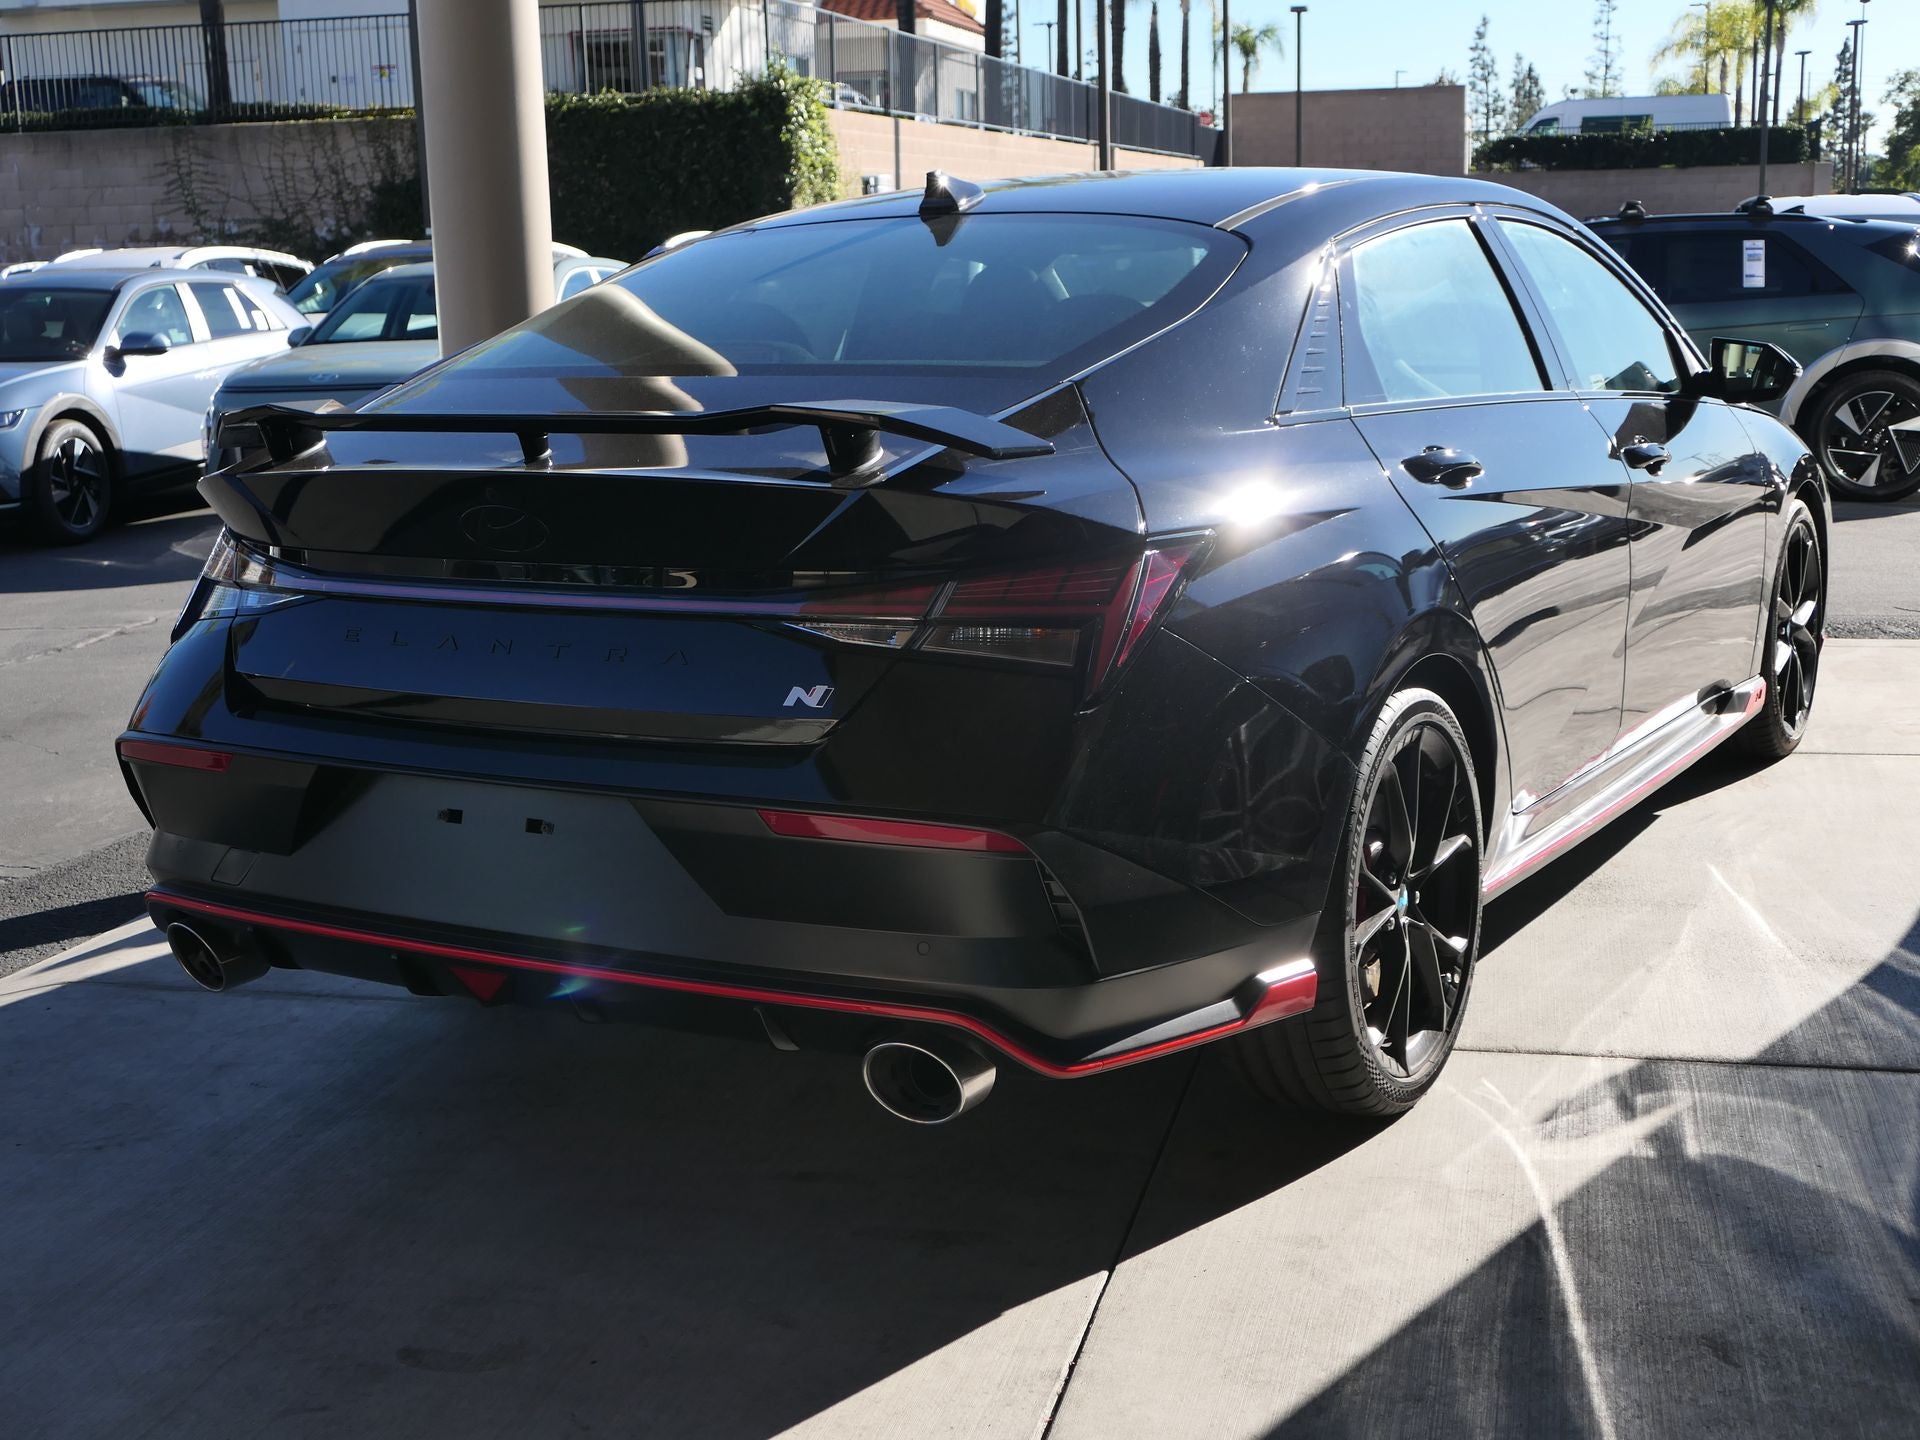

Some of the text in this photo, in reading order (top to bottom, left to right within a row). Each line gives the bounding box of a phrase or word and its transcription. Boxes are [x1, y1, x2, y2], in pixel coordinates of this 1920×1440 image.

[343, 627, 689, 666] ELANTRA
[782, 684, 835, 708] N
[1347, 798, 1367, 897] MICHELIN
